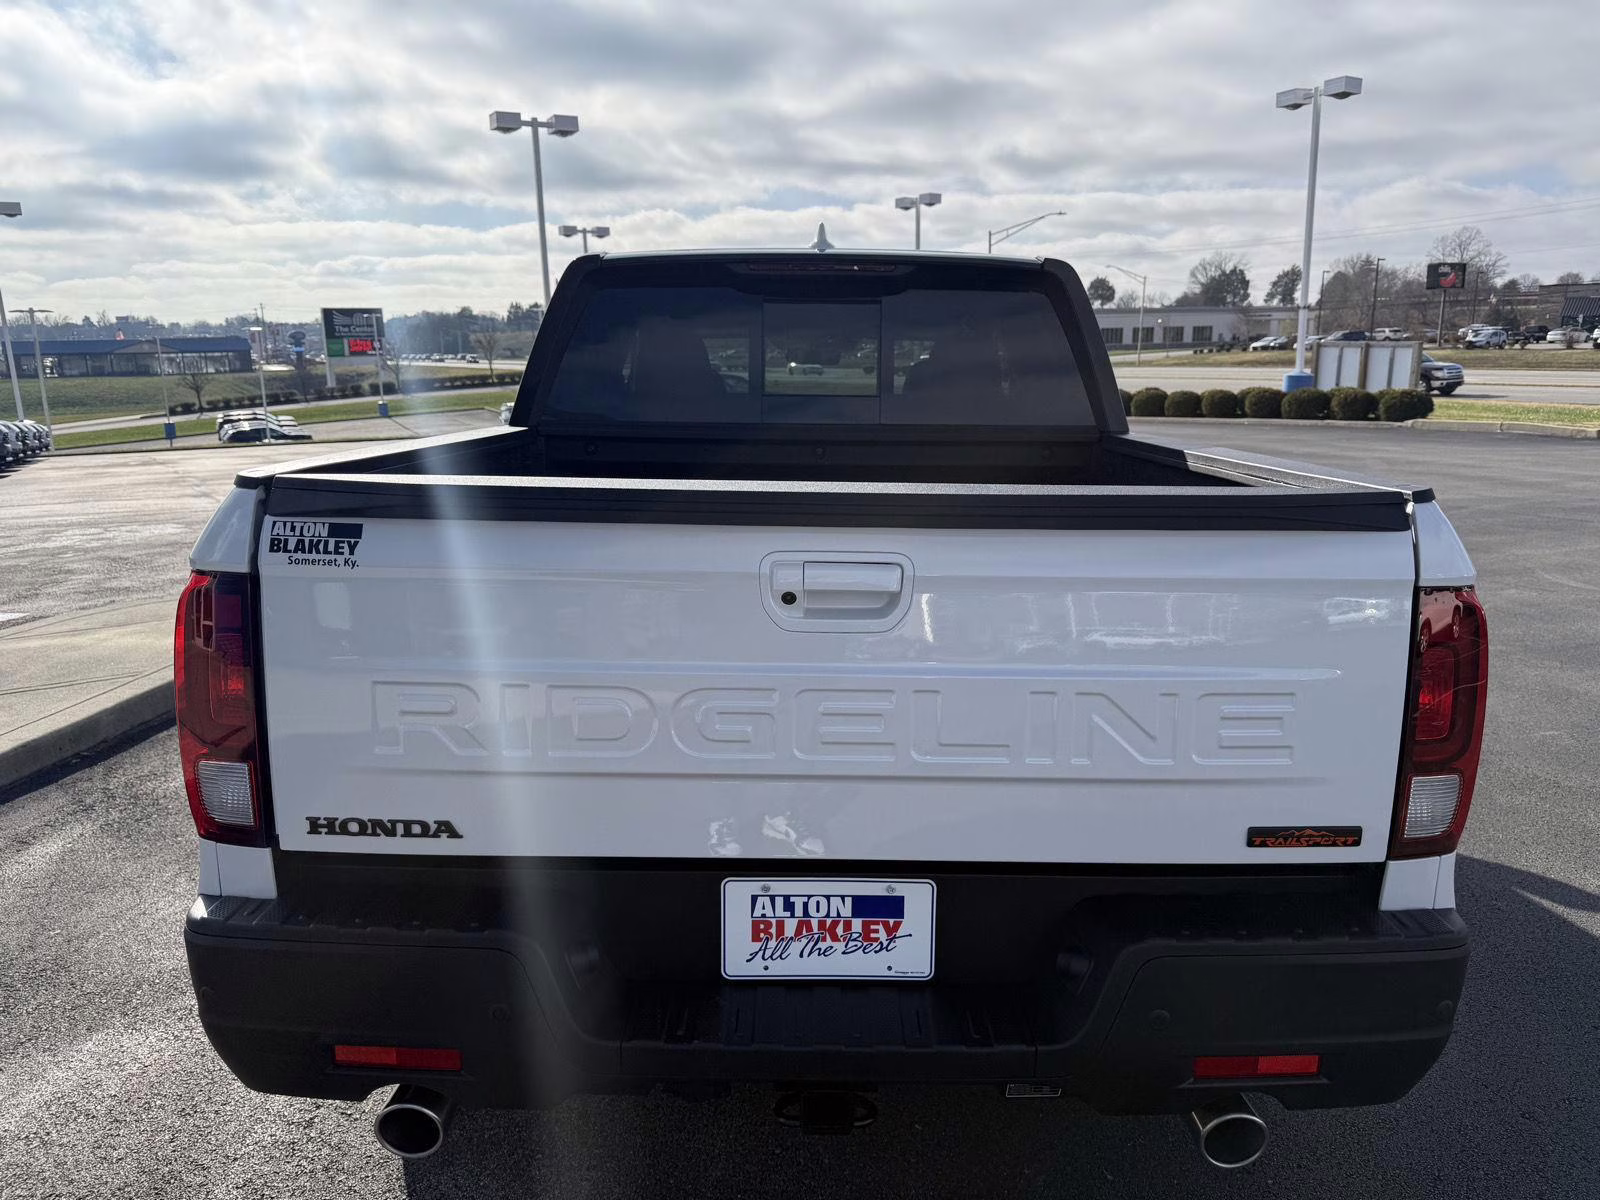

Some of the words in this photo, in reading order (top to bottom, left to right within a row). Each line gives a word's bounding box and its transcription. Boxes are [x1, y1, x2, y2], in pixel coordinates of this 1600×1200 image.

[272, 521, 329, 537] ALTON
[268, 537, 360, 556] BLAKLEY
[287, 555, 341, 568] Somerset,
[343, 557, 360, 570] Ky.
[371, 680, 1296, 765] RIDGELINE
[305, 816, 464, 839] HONDA
[1251, 836, 1359, 847] TRAILSPORT
[752, 896, 853, 918] ALTON
[751, 919, 903, 943] BLAKLEY
[745, 936, 795, 963] All
[796, 931, 837, 959] The
[839, 931, 913, 955] Best
